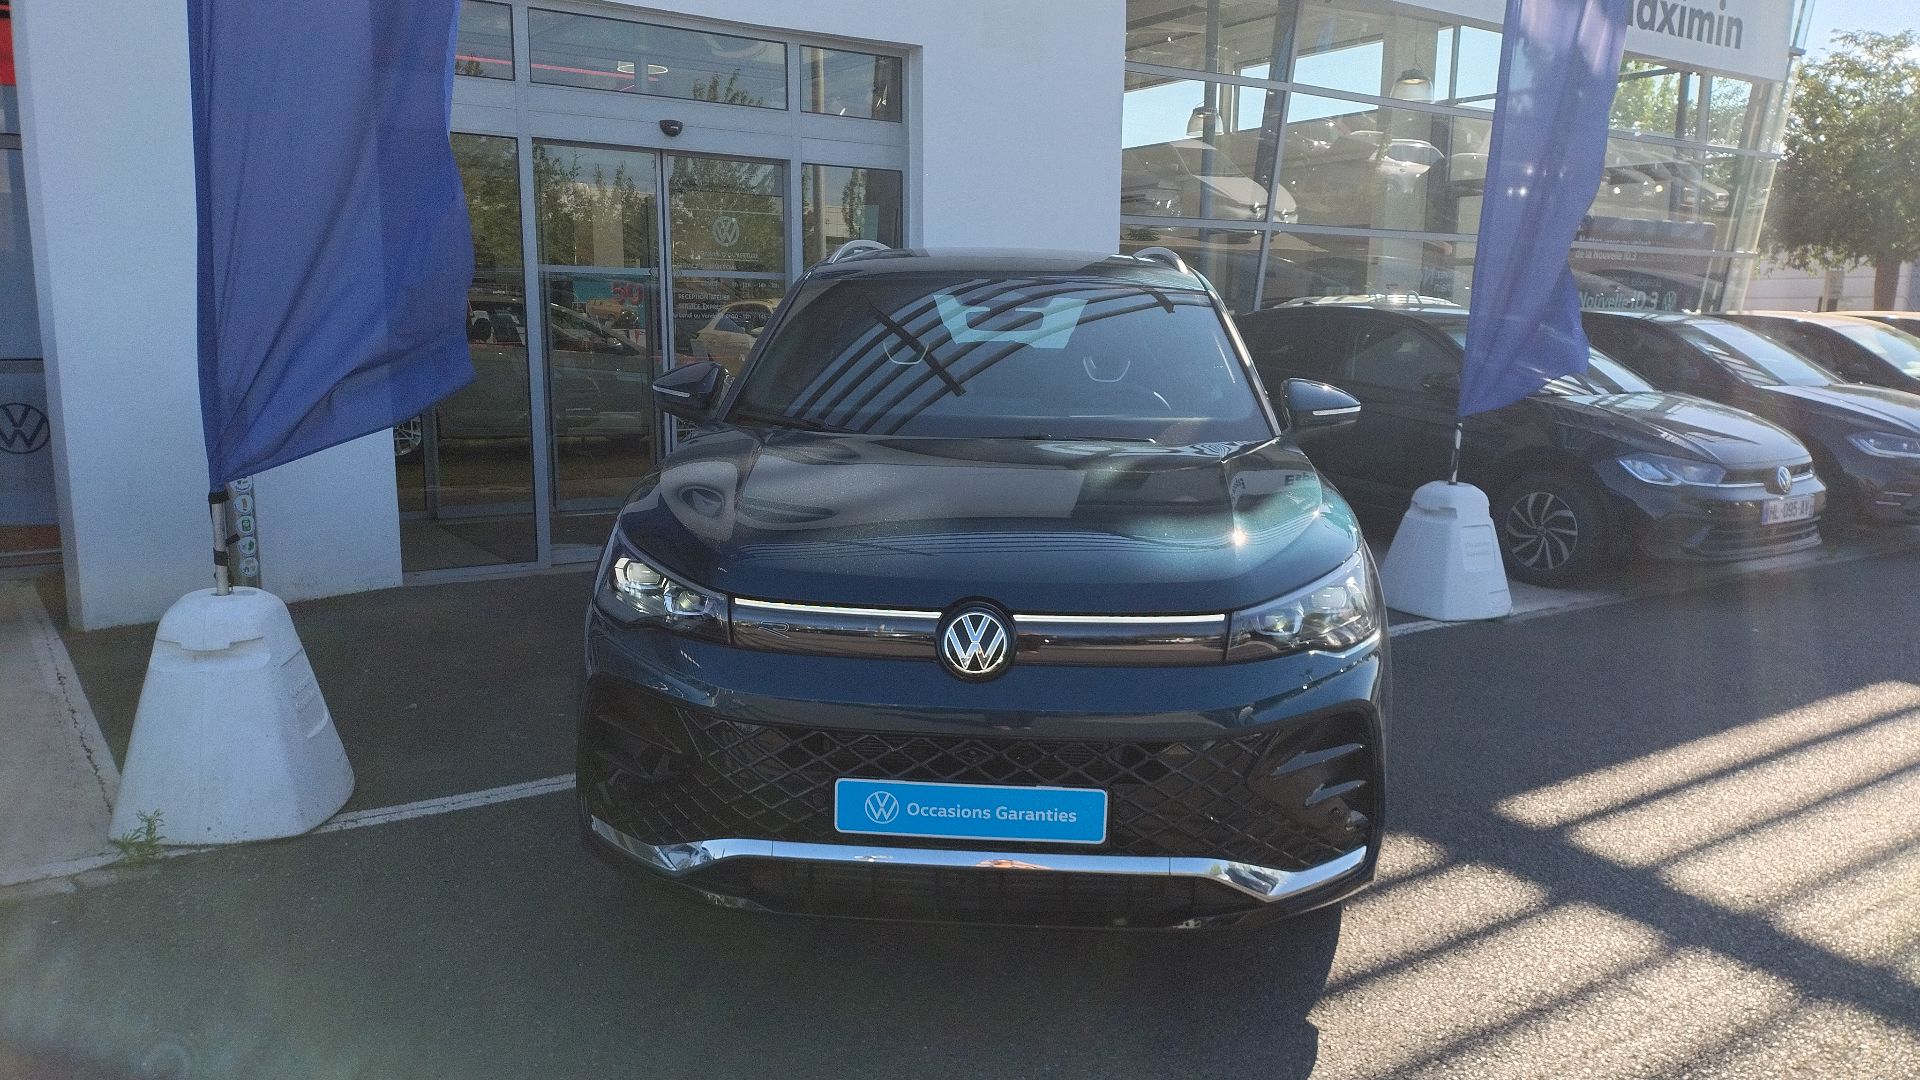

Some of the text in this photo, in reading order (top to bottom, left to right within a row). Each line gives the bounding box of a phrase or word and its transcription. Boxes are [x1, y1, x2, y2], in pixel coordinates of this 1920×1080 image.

[1579, 291, 1630, 309] Nouvelle
[944, 611, 1007, 673] VW
[865, 791, 1077, 824] VW Occasions Garanties
